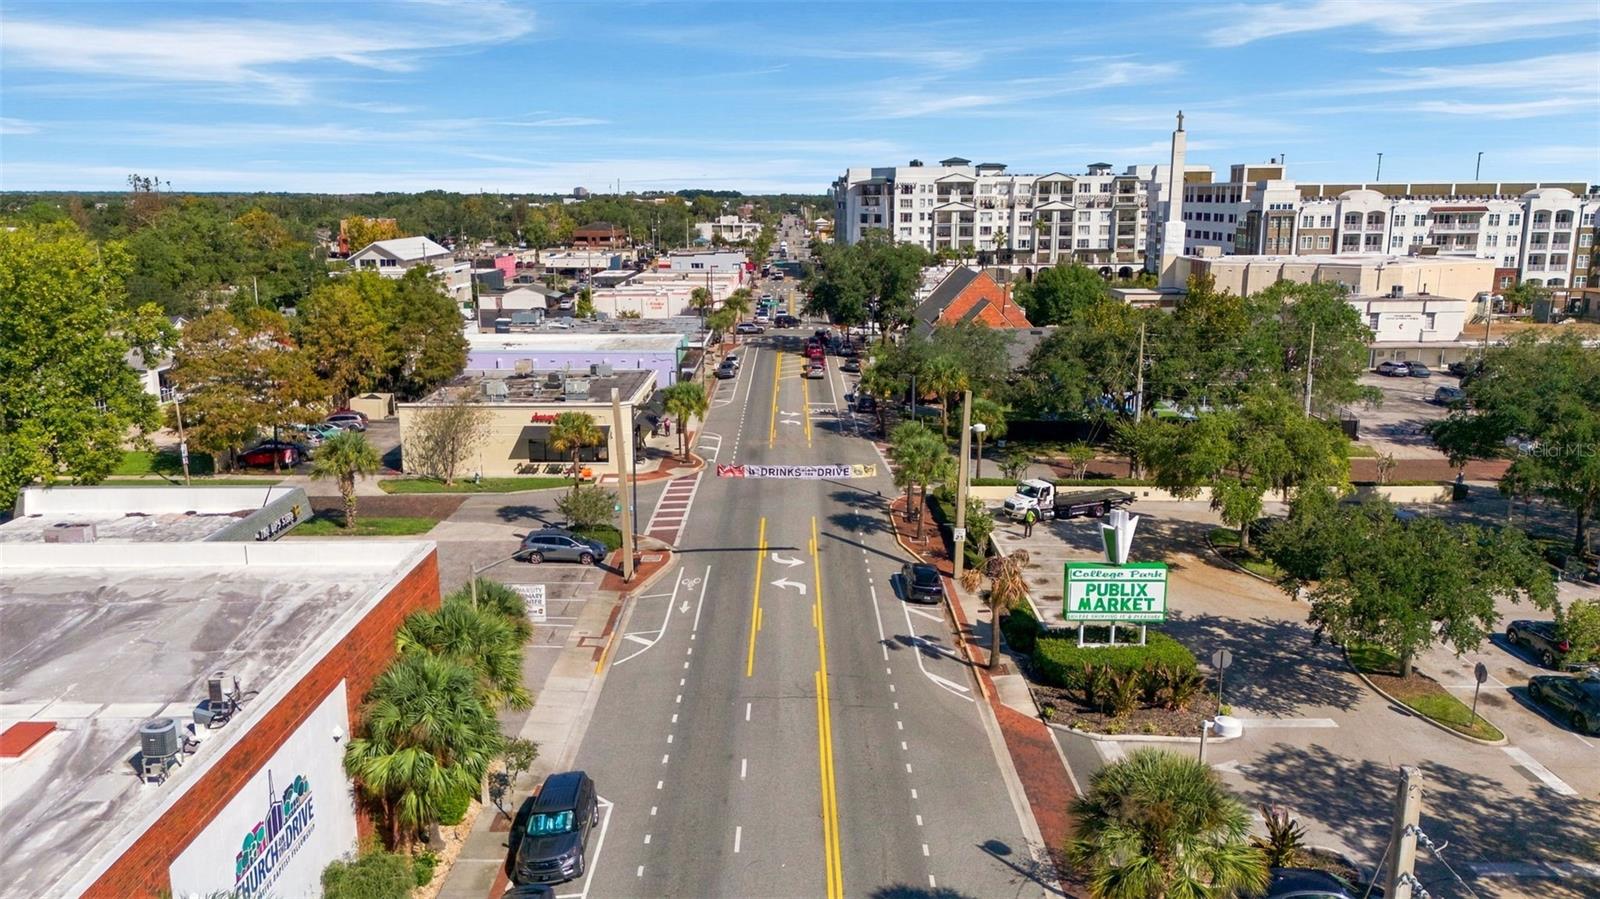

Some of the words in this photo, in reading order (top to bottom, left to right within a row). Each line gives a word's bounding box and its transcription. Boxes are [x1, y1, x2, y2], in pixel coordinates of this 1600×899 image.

[760, 467, 802, 477] DRINKS
[817, 467, 850, 477] DRIVE
[1072, 570, 1124, 578] College
[1130, 570, 1163, 578] Park
[1085, 584, 1148, 596] PUBLIX
[1078, 598, 1155, 610] MARKET
[285, 798, 314, 850] DRIVE
